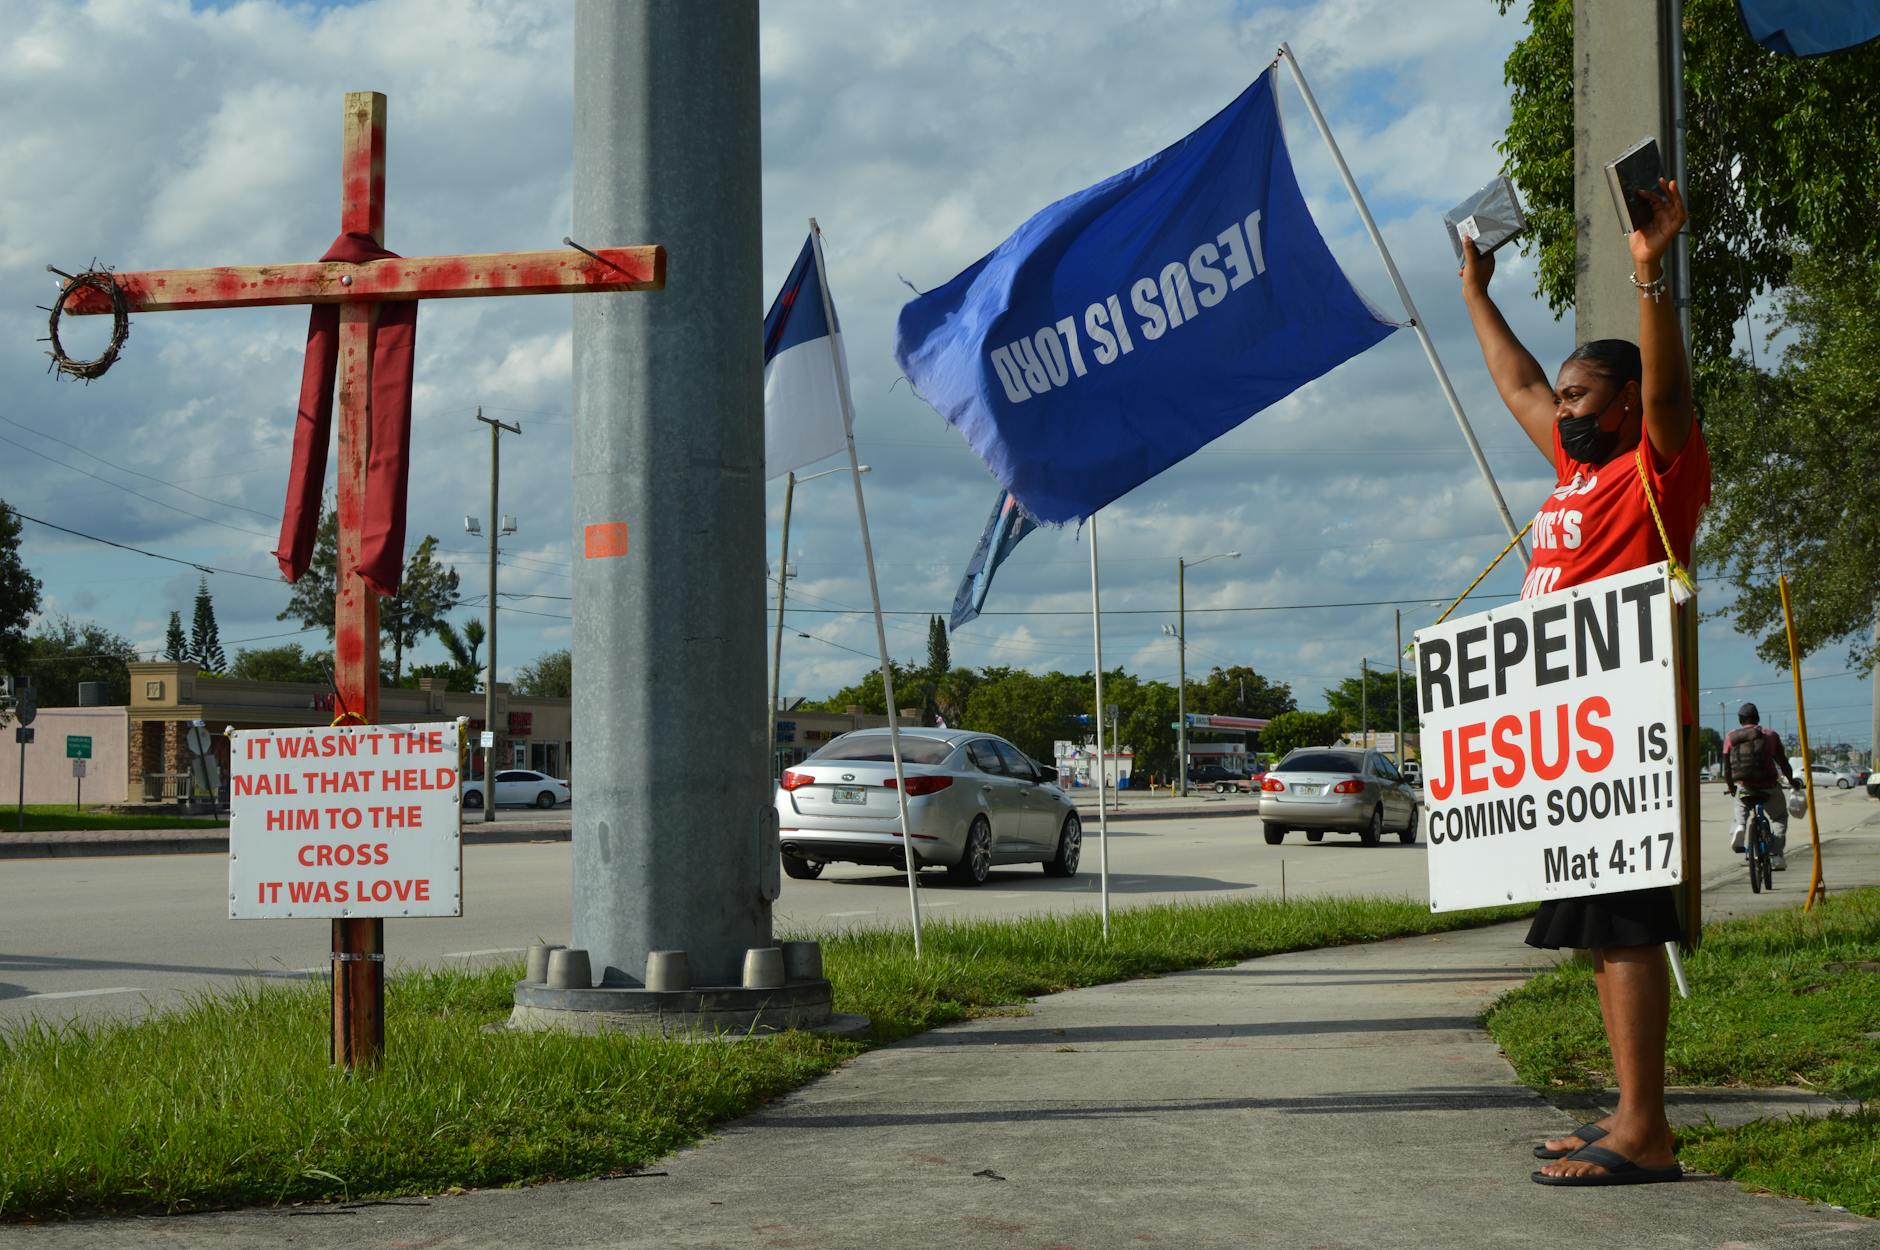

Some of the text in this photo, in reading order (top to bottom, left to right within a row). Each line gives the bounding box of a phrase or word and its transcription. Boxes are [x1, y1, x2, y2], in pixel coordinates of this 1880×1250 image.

[991, 209, 1266, 403] JESUS IS LORD
[1420, 578, 1665, 713] REPENT
[247, 731, 442, 759] IT WASN'T THE
[1430, 696, 1668, 800] JESUS IS
[235, 768, 455, 796] NAIL THAT HELD
[267, 806, 422, 831] HIM TO THE
[1429, 771, 1673, 845] COMING SOON!!!
[298, 843, 389, 866] CROSS
[1544, 832, 1674, 883] Mat 4:17
[259, 880, 430, 904] IT WAS LOVE
